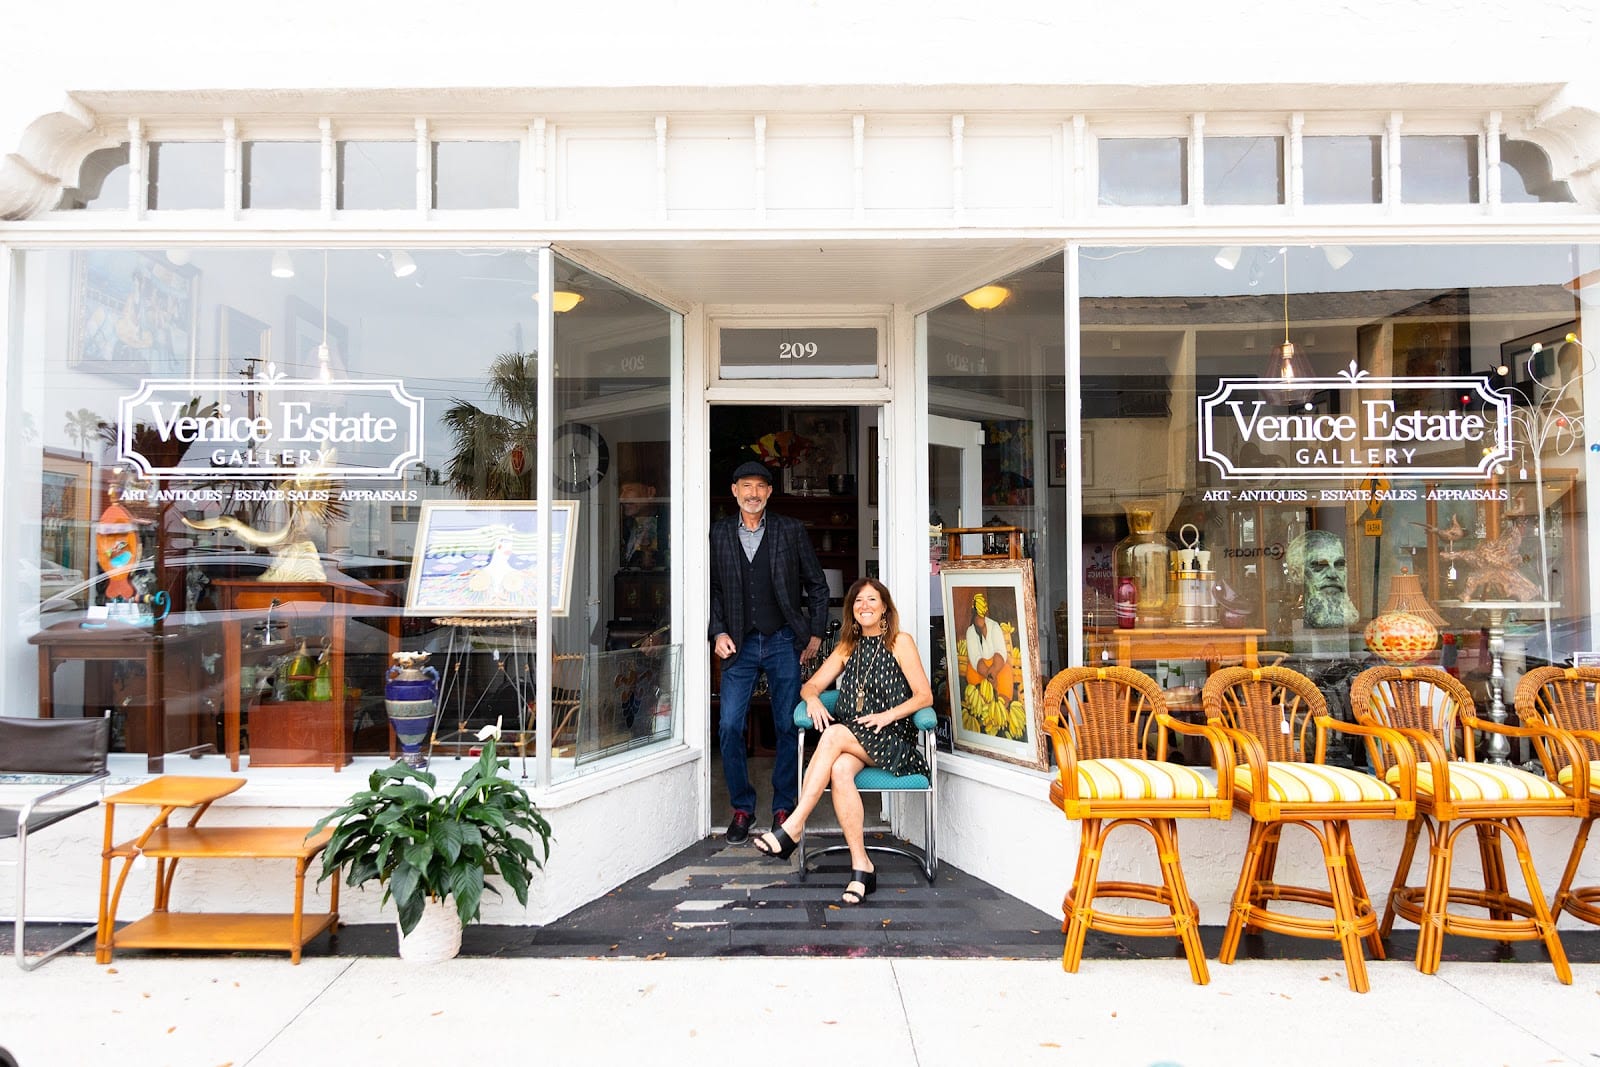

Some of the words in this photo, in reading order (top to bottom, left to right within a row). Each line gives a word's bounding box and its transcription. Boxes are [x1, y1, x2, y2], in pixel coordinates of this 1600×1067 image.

[780, 342, 818, 359] 209
[145, 401, 274, 443] Venice
[278, 401, 397, 443] Estate
[1225, 400, 1356, 442] Venice
[1362, 400, 1484, 442] Estate
[211, 448, 330, 466] GALLERY
[1296, 448, 1417, 465] GALLERY
[119, 489, 148, 501] ART
[154, 489, 223, 503] ANTIQUES
[235, 489, 285, 501] ESTATE
[288, 489, 330, 501] SALES
[338, 489, 418, 501] APPRAISALS
[1202, 489, 1231, 501] ART
[1237, 489, 1308, 503] ANTIQUES
[1320, 489, 1372, 501] ESTATE
[1375, 489, 1418, 501] SALES
[1426, 489, 1508, 501] APPRAISALS
